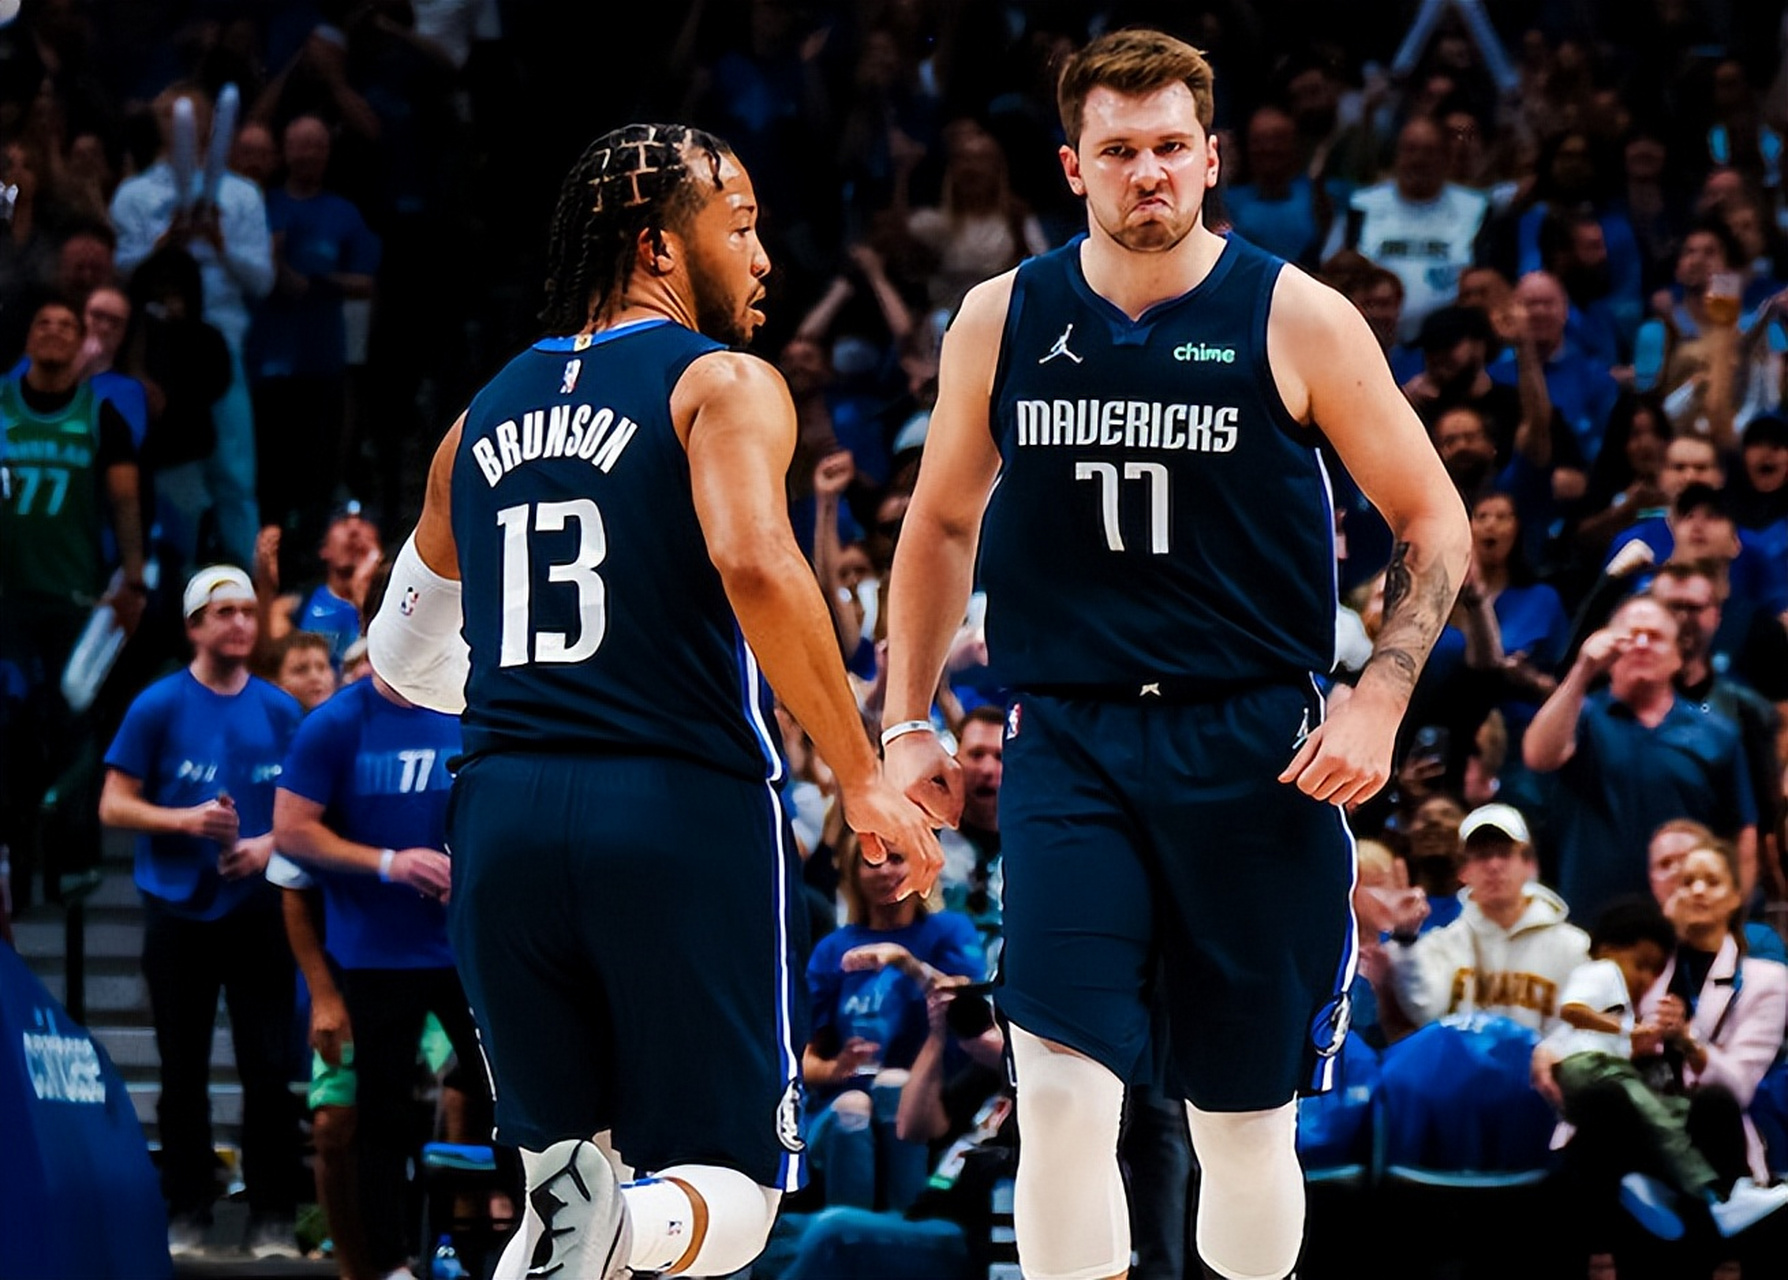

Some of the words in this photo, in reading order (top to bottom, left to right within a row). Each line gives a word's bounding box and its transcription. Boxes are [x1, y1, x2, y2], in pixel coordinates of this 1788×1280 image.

[1173, 342, 1236, 363] chime
[472, 403, 638, 489] BRUNSON
[1016, 399, 1239, 453] MAVERICKS
[15, 466, 71, 516] 77
[1075, 461, 1169, 555] 77
[496, 498, 608, 668] 13
